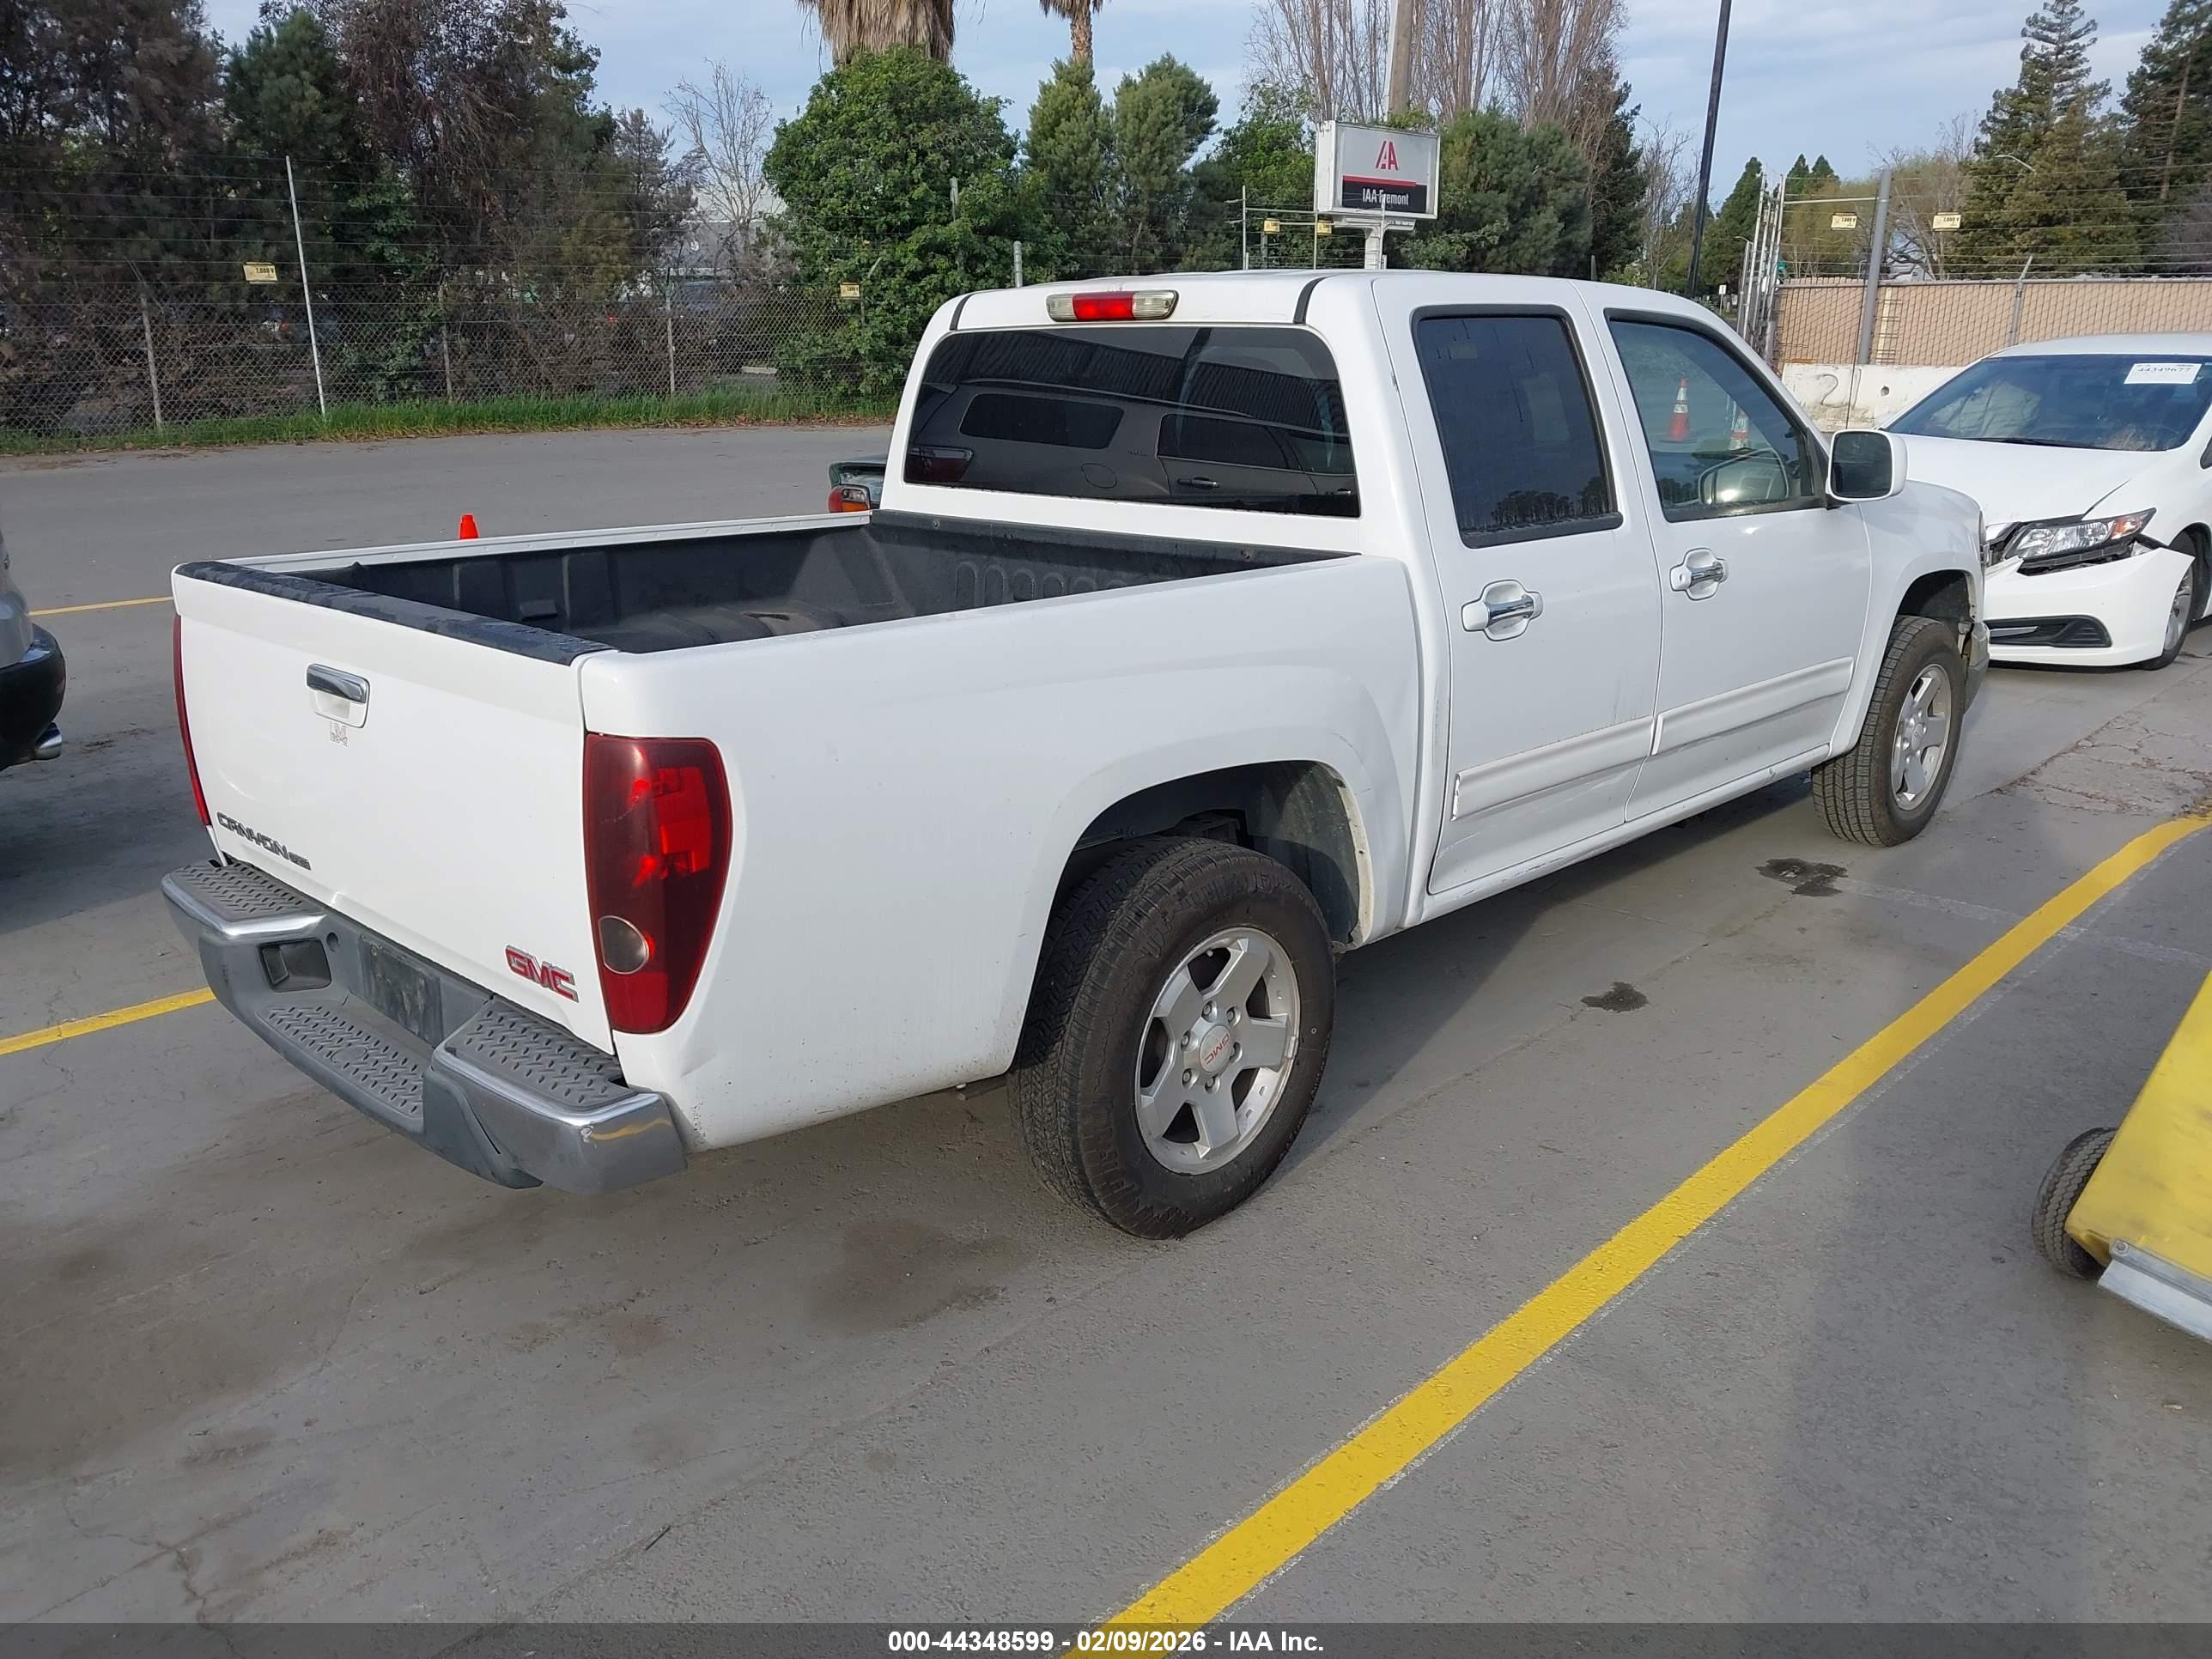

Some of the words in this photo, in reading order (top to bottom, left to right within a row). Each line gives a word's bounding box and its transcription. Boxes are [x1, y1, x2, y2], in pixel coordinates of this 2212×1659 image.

[1363, 188, 1377, 203] IAA
[1379, 189, 1408, 205] Femont
[216, 811, 289, 860] CANYON
[505, 945, 580, 1003] GMC
[1204, 1033, 1231, 1065] GMC
